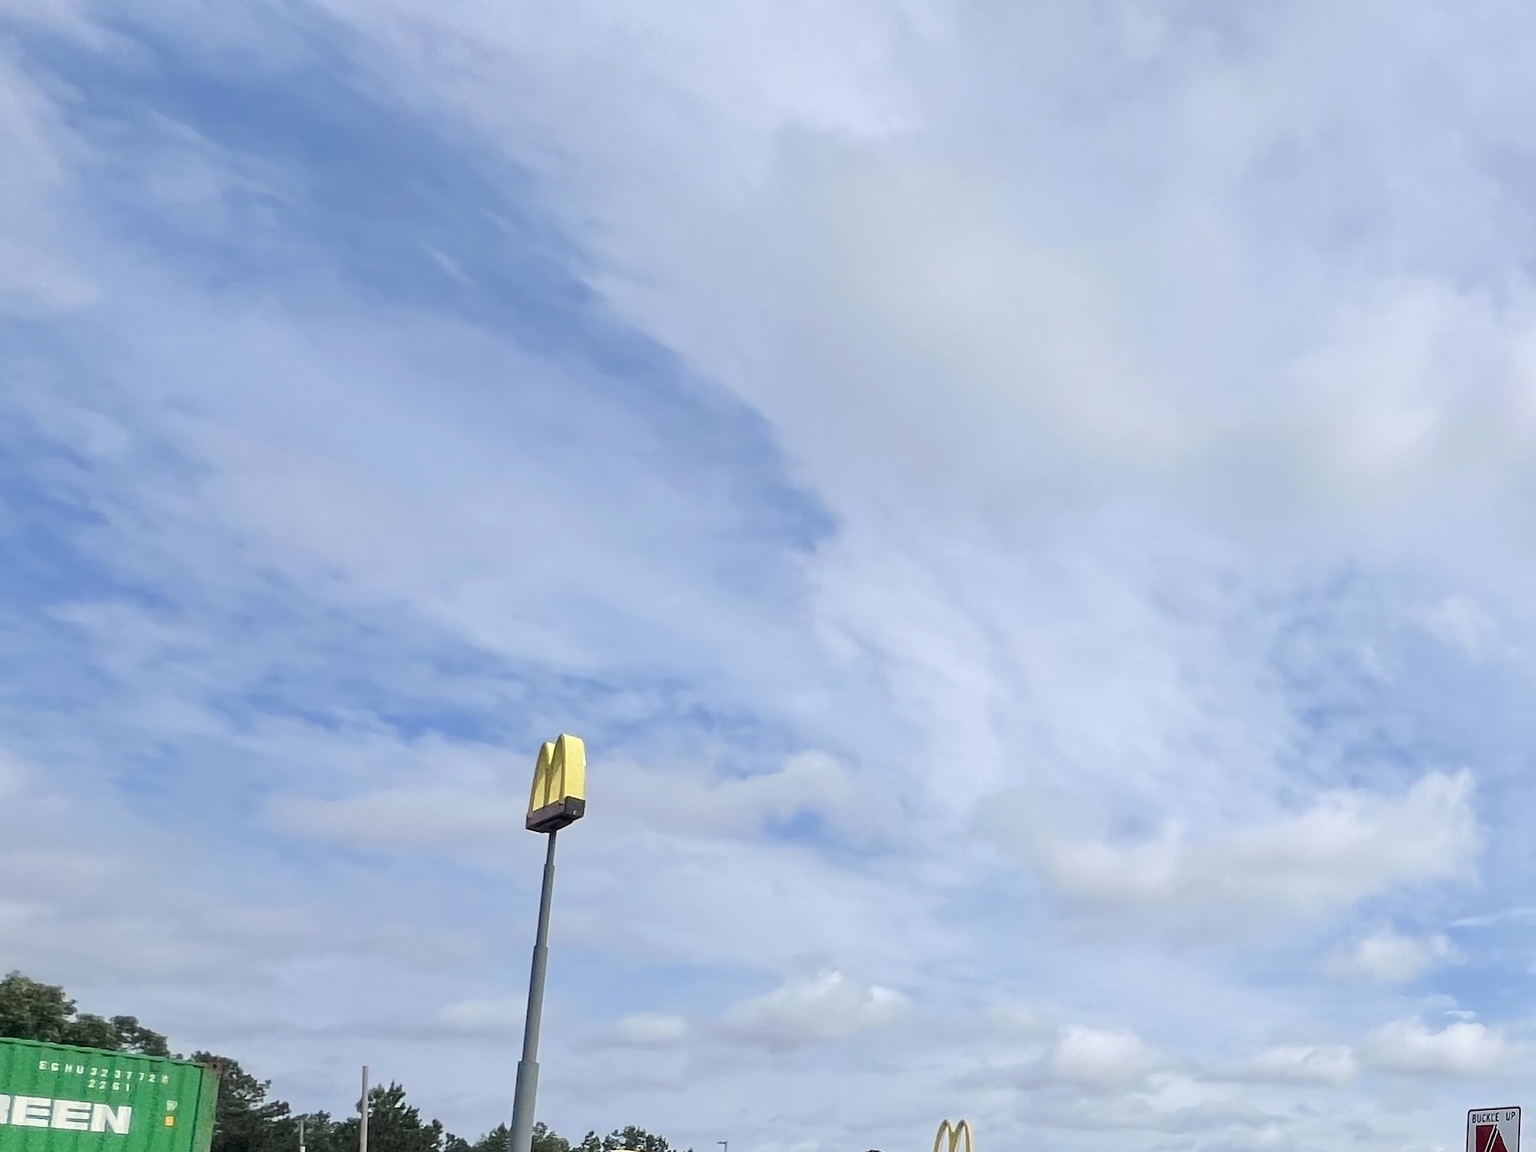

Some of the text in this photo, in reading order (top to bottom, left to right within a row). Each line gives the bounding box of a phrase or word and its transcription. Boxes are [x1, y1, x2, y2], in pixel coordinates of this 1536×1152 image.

[0, 1094, 132, 1135] EEN
[1472, 1111, 1516, 1124] BUCKLE UP
